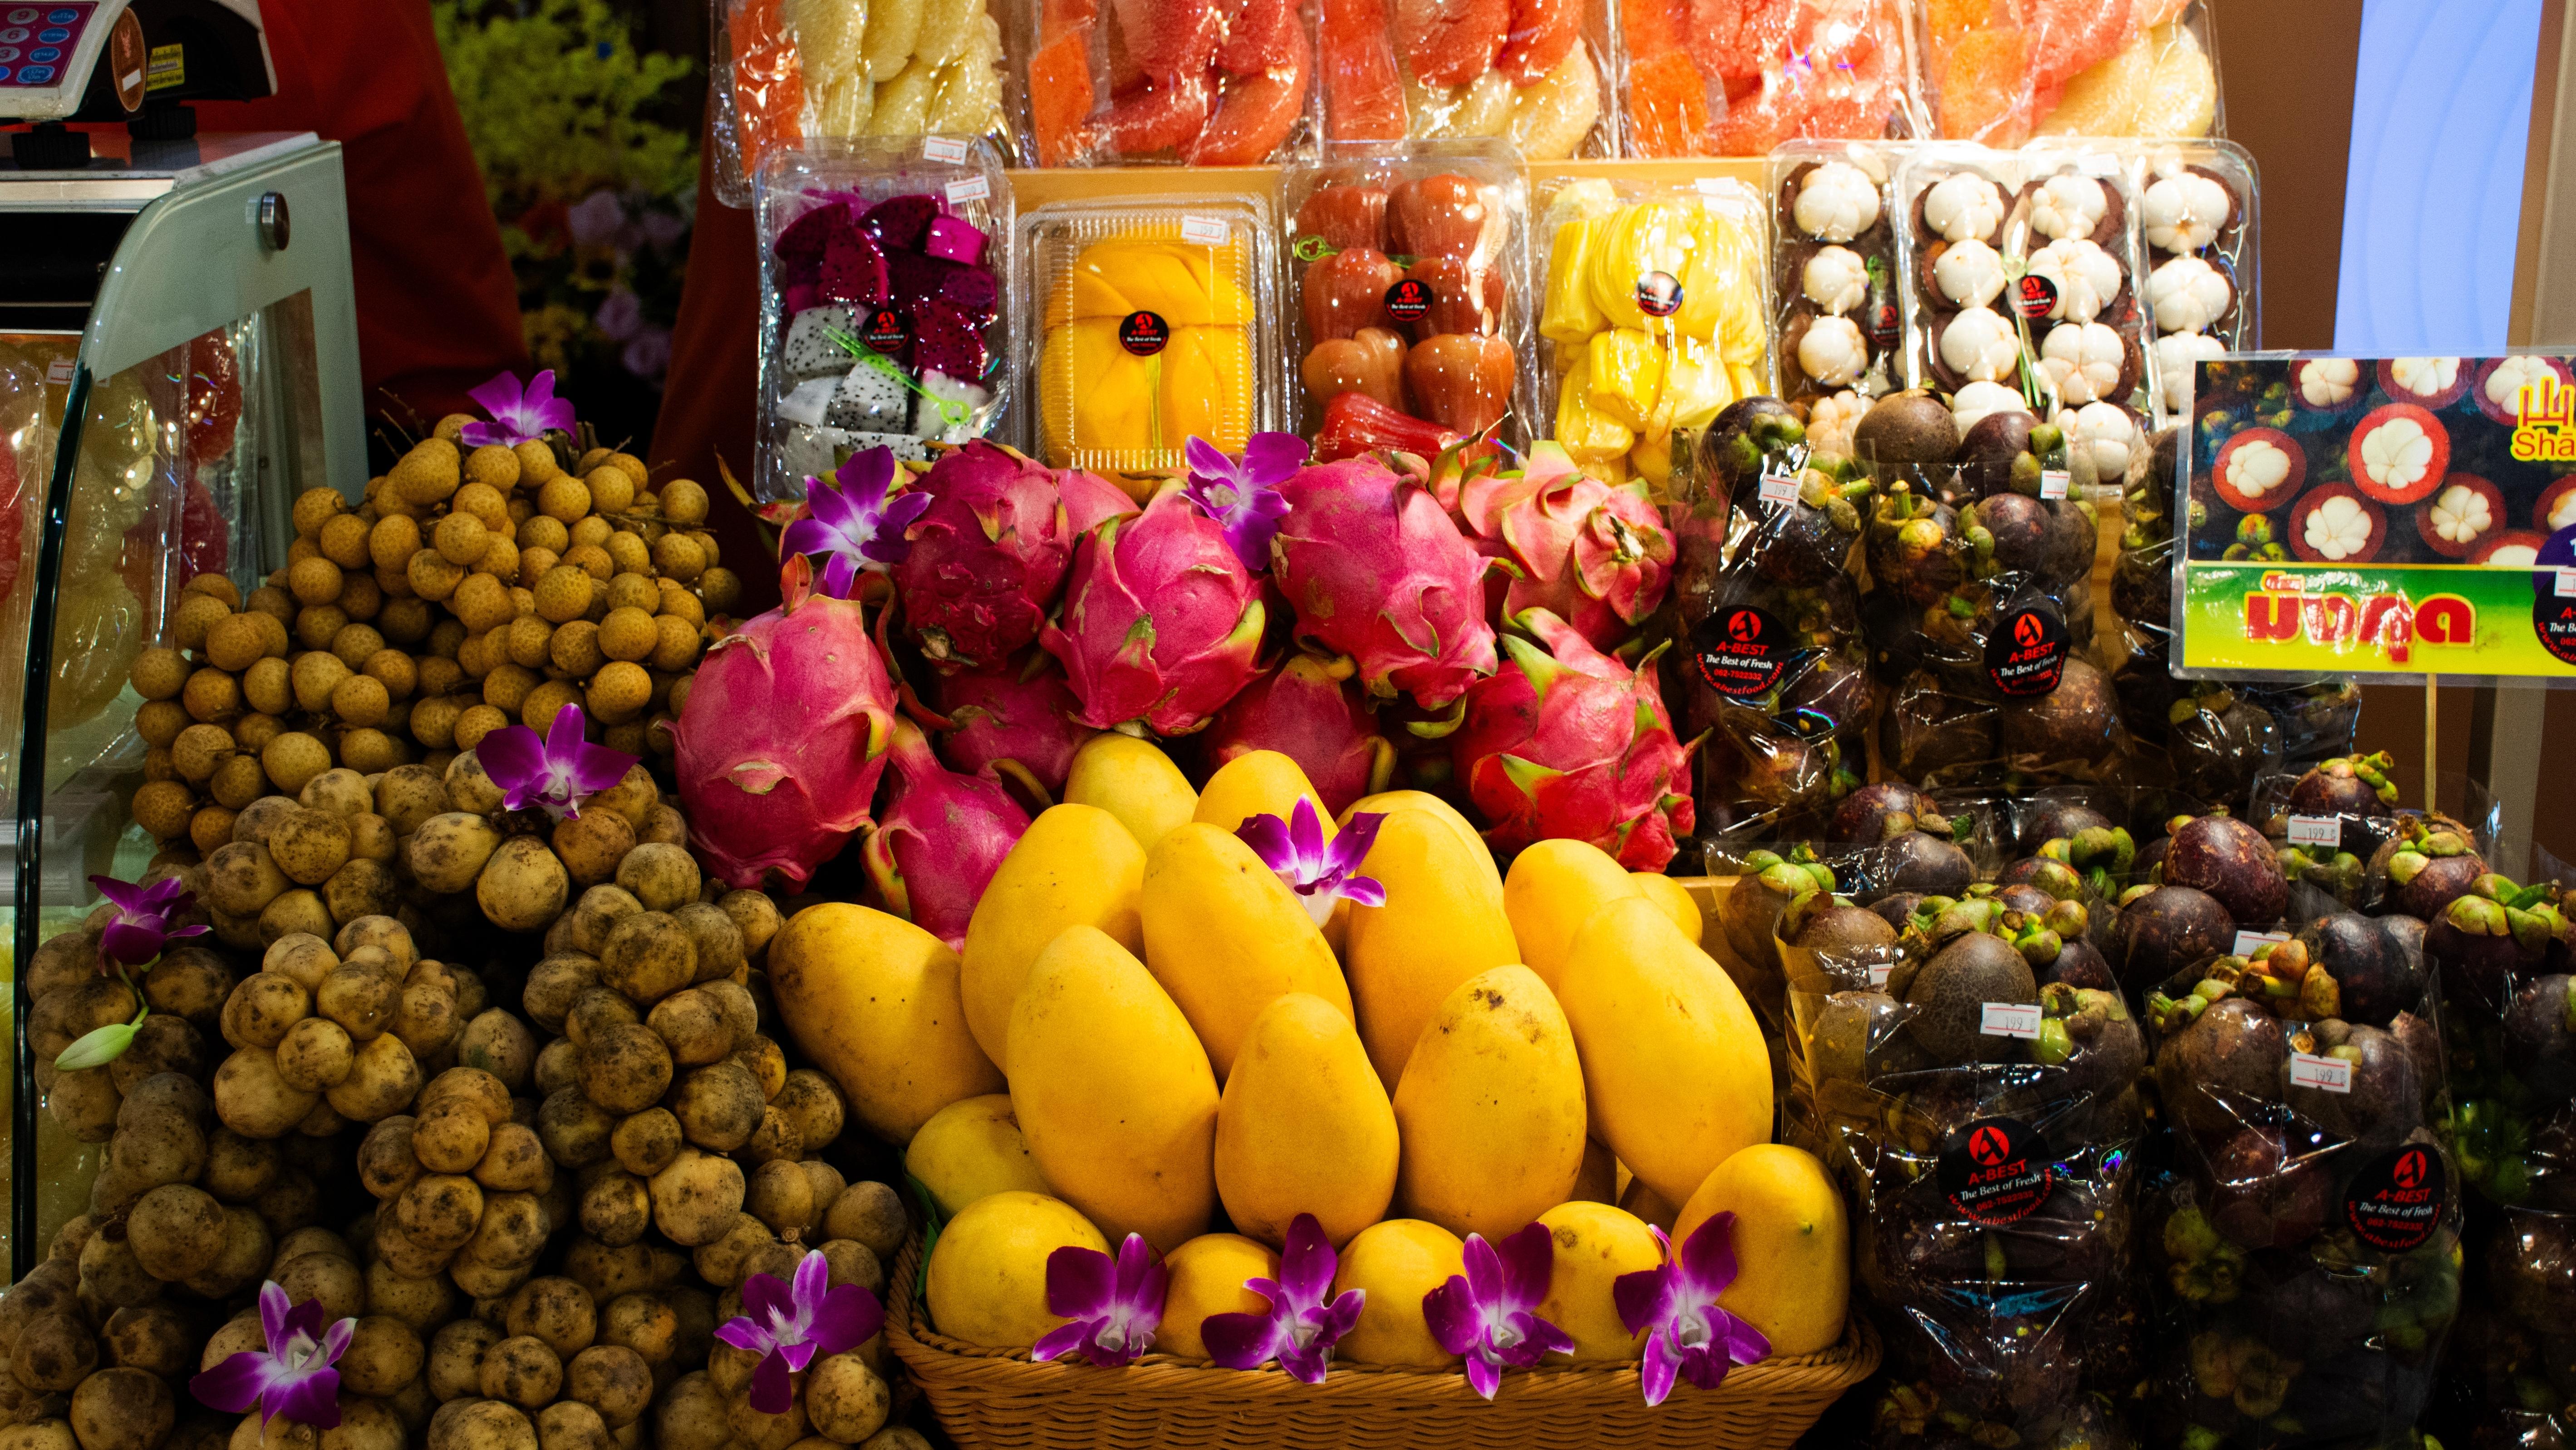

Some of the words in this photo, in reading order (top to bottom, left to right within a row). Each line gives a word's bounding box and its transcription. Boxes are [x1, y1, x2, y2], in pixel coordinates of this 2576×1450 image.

[2549, 623, 2565, 632] The
[1716, 641, 1769, 656] A-BEST
[2008, 641, 2055, 664] A-BEST
[1706, 654, 1720, 664] The
[1721, 656, 1738, 666] Best
[1740, 659, 1750, 668] of
[1750, 659, 1772, 669] Fresh
[2001, 667, 2015, 677] The
[2016, 664, 2033, 674] Best
[2034, 660, 2042, 670] of
[2308, 828, 2325, 840] 199
[2006, 1016, 2023, 1031] 199
[2315, 1068, 2333, 1082] 199
[1968, 1159, 2026, 1186] A-BEST
[1961, 1190, 1977, 1201] The
[1980, 1184, 2000, 1196] Best
[2002, 1181, 2014, 1191] of
[2016, 1174, 2041, 1188] Fresh
[2374, 1188, 2432, 1203] A-BEST
[2360, 1202, 2377, 1213] The
[2378, 1204, 2400, 1216] Best
[2401, 1207, 2414, 1217] of
[2414, 1205, 2433, 1218] Fresh
